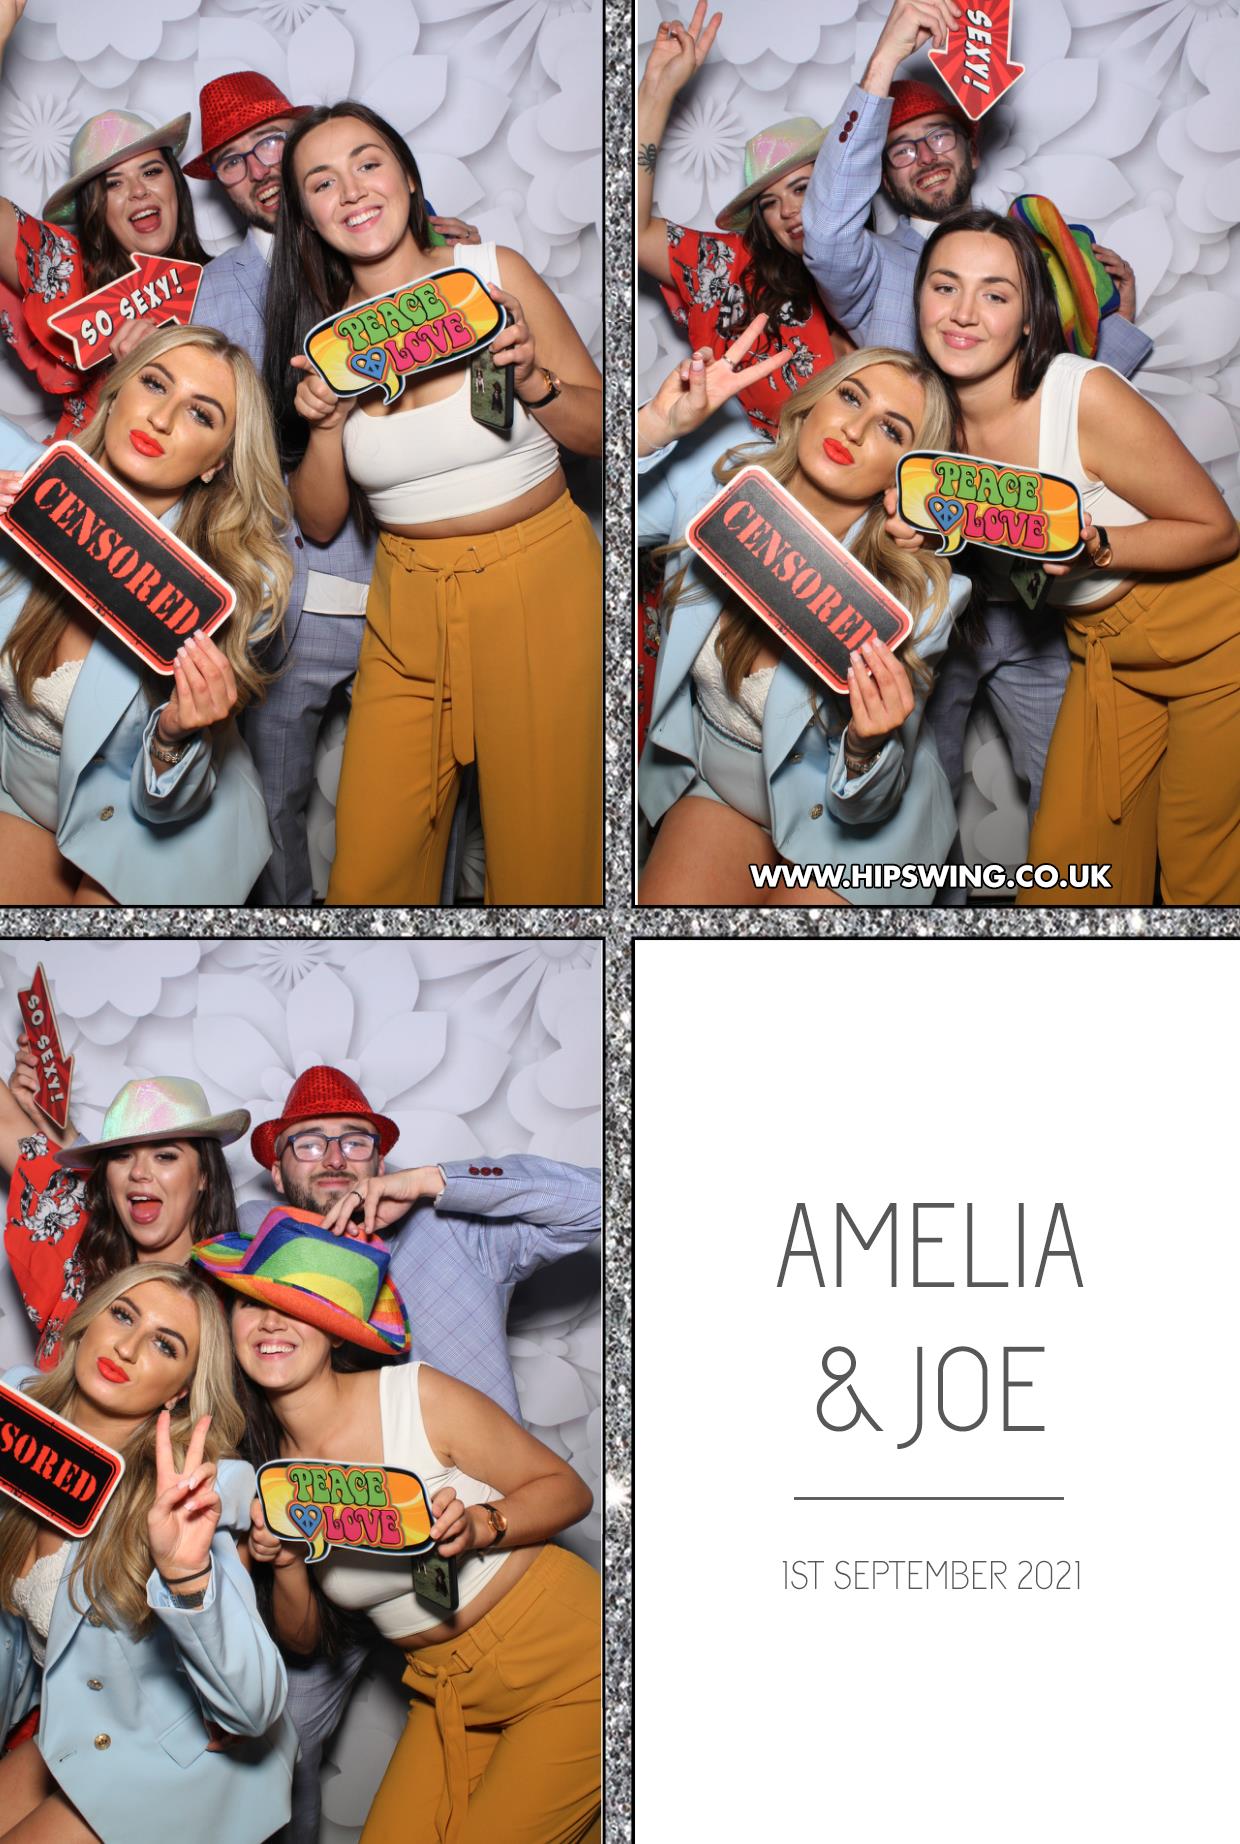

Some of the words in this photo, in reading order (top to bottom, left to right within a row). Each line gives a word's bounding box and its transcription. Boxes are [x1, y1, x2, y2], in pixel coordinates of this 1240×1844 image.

[963, 9, 993, 95] SEXY!
[81, 309, 114, 346] SO
[119, 268, 184, 321] SEXY!
[338, 283, 446, 350] PEACE
[390, 315, 473, 374] LOVE
[935, 460, 1040, 512] PEACE
[34, 476, 200, 635] CENSORED
[964, 509, 1046, 551] LOVE
[27, 994, 45, 1026] SO
[37, 1034, 65, 1103] SEXY!
[0, 1417, 97, 1502] SORED
[290, 1467, 388, 1506] PEACE
[324, 1506, 402, 1545] LOVE
